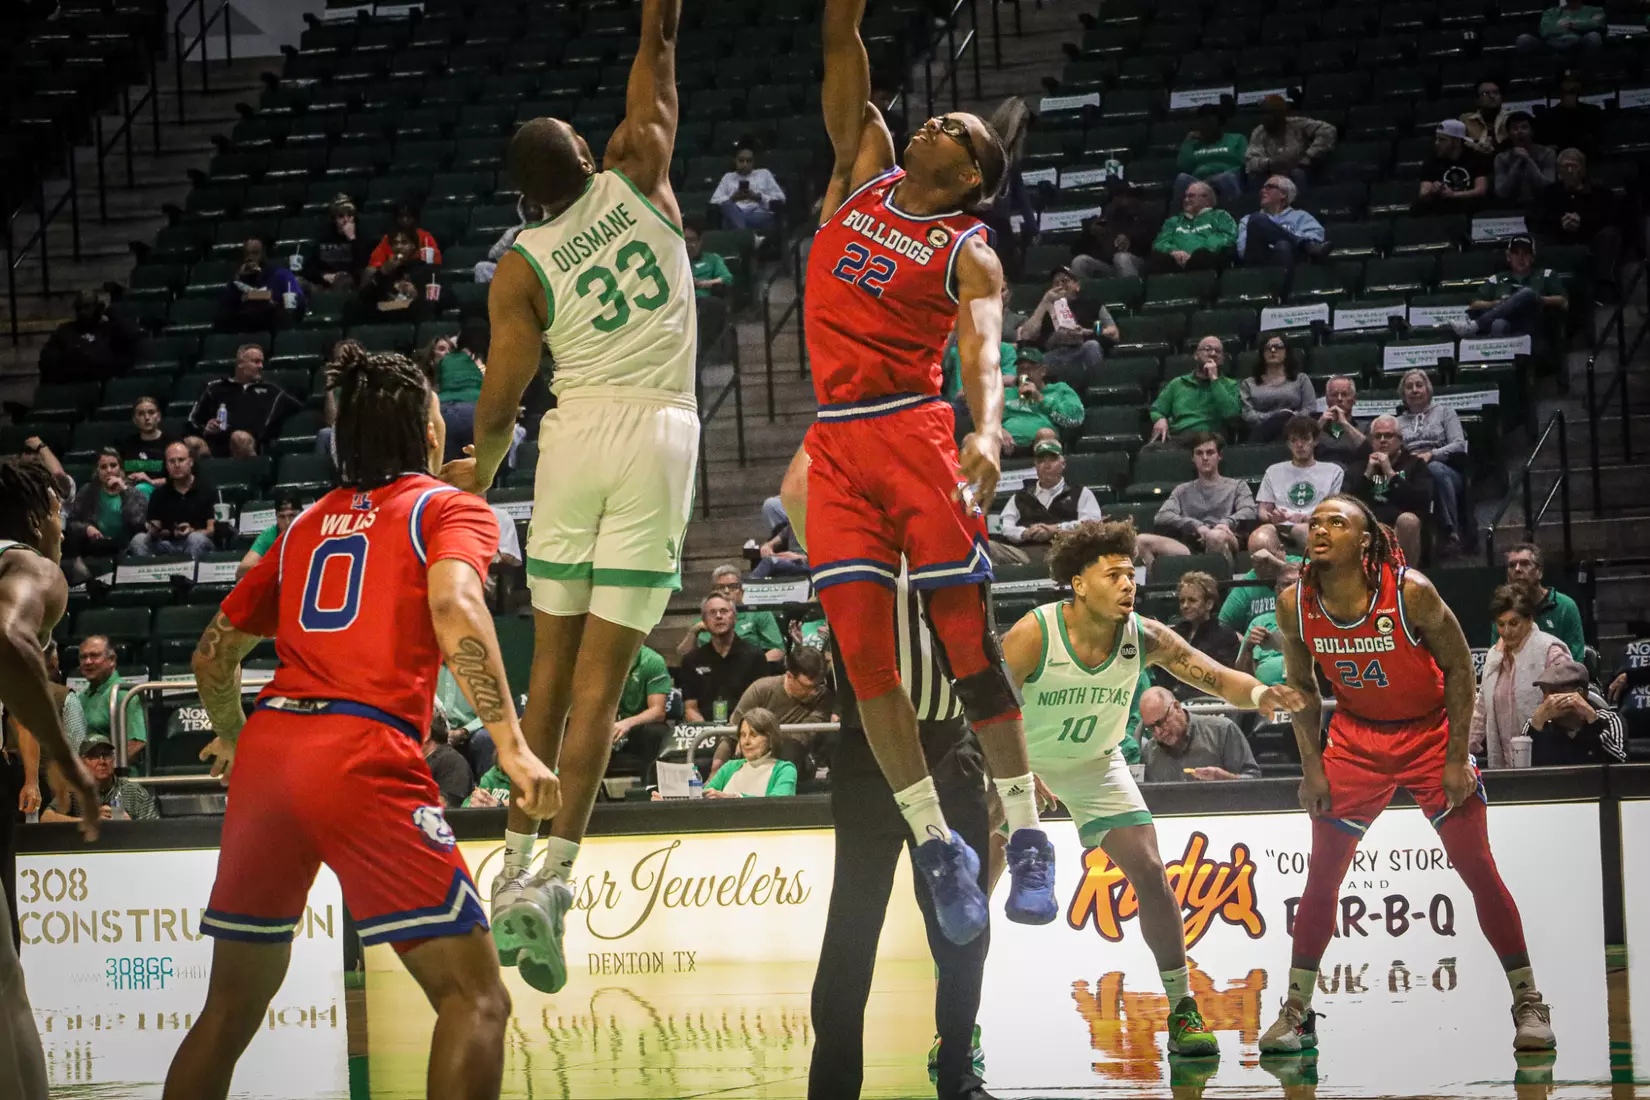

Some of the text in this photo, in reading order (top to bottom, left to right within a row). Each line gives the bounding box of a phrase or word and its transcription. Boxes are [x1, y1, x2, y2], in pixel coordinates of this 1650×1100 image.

[552, 203, 637, 272] OUSMANE
[842, 209, 935, 266] BULLDOGS
[576, 240, 671, 333] 33
[832, 242, 898, 299] 22
[299, 532, 369, 632] 0
[1313, 636, 1396, 653] BULLDOGS
[1335, 660, 1389, 688] 24
[1037, 687, 1130, 707] NORTH TEXAS
[182, 719, 212, 731] TEX
[1057, 715, 1098, 743] 10
[676, 736, 716, 750] TEAS
[20, 868, 88, 903] 308
[587, 839, 812, 940] Jewelers
[1067, 831, 1266, 951] Rdy's
[1348, 880, 1389, 889] AND
[19, 904, 334, 945] CONSTRUN
[589, 950, 697, 975] DENTON TX
